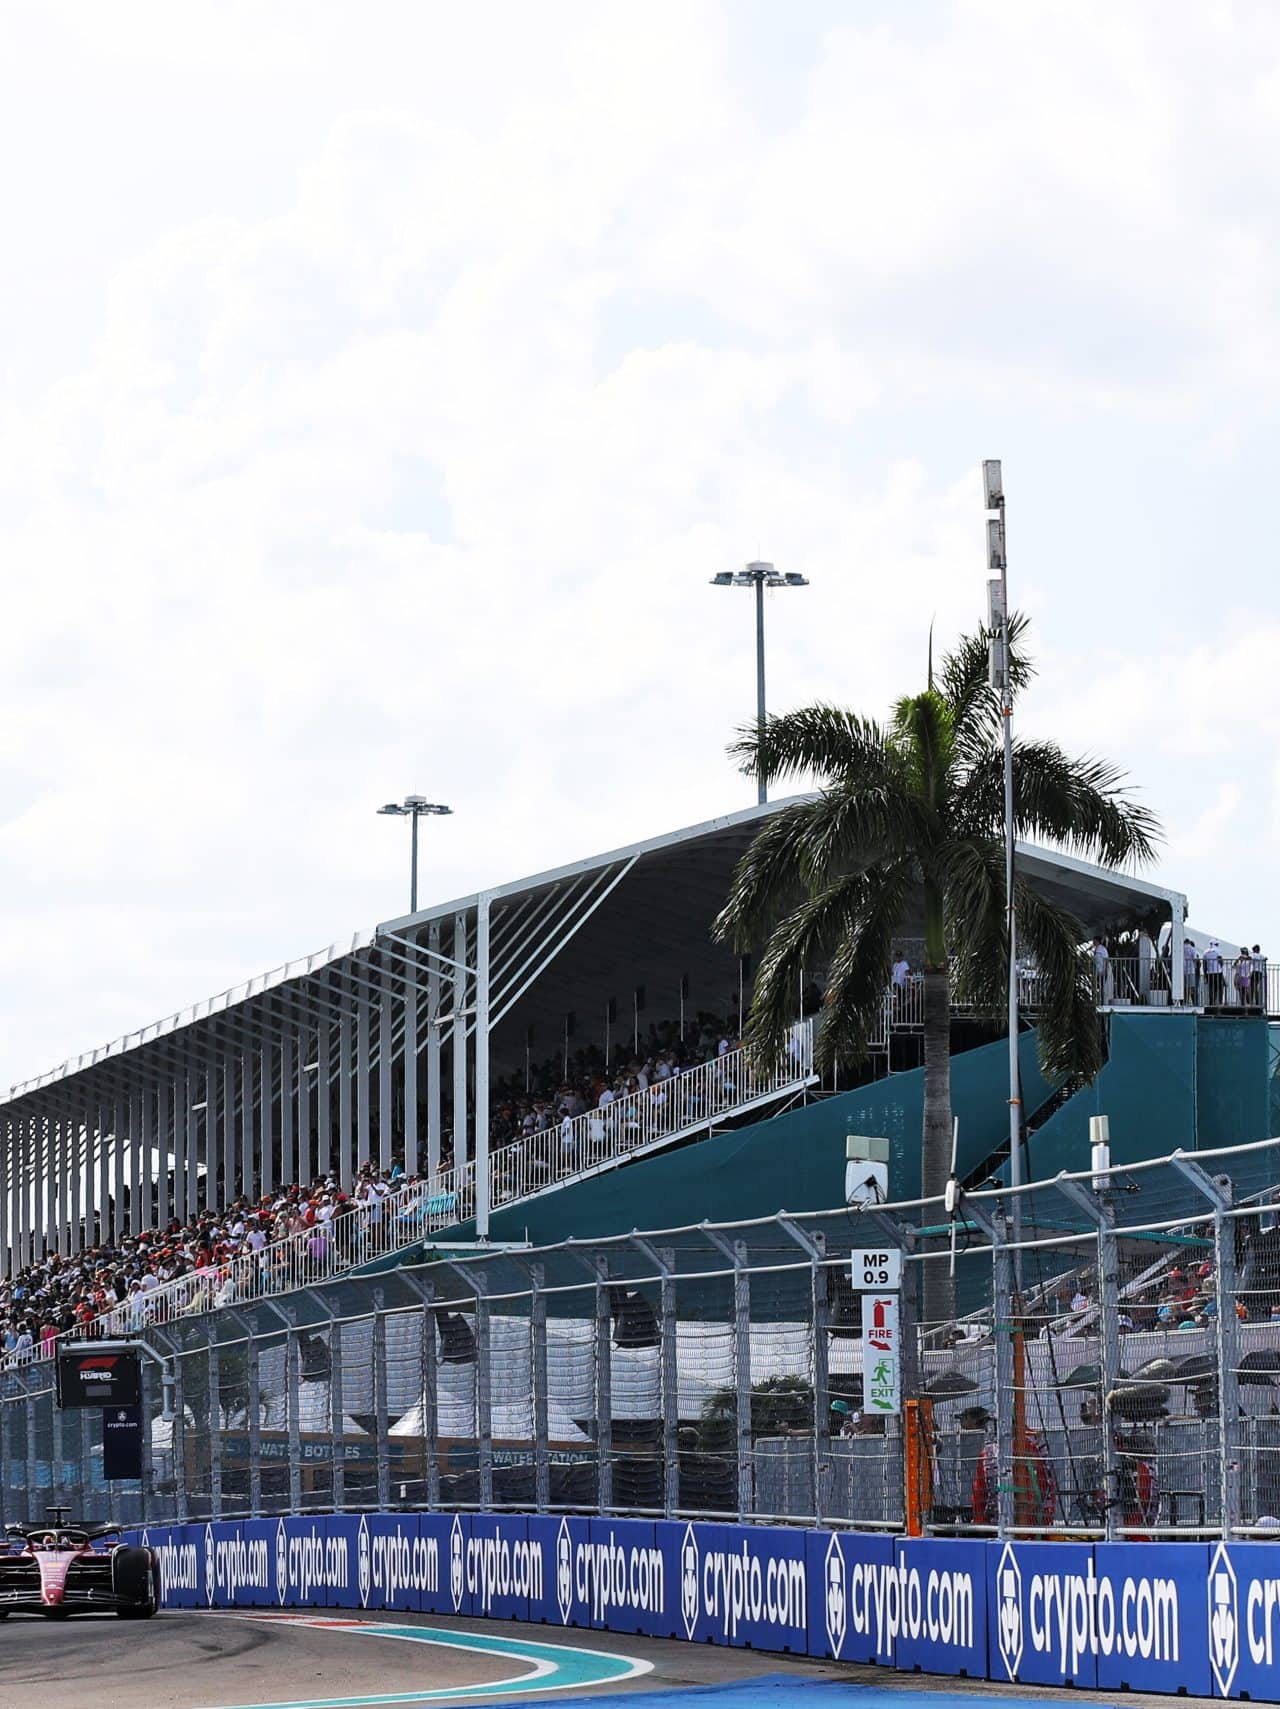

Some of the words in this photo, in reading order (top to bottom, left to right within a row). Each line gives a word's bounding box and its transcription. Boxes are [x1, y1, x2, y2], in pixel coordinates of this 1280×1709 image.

[864, 1254, 889, 1267] MP
[864, 1271, 889, 1284] 0.9
[868, 1330, 893, 1338] FIRE
[107, 1422, 138, 1430] crypto.com
[871, 1389, 895, 1398] EXIT
[216, 1531, 268, 1600] crypto.com
[289, 1527, 348, 1599] crypto.com
[372, 1525, 439, 1602] crypto.com
[466, 1526, 543, 1610] crypto.com
[576, 1531, 665, 1621] crypto.com
[703, 1540, 807, 1638] crypto.com
[852, 1550, 974, 1657] crypto.com
[1029, 1556, 1179, 1675] crypto.com
